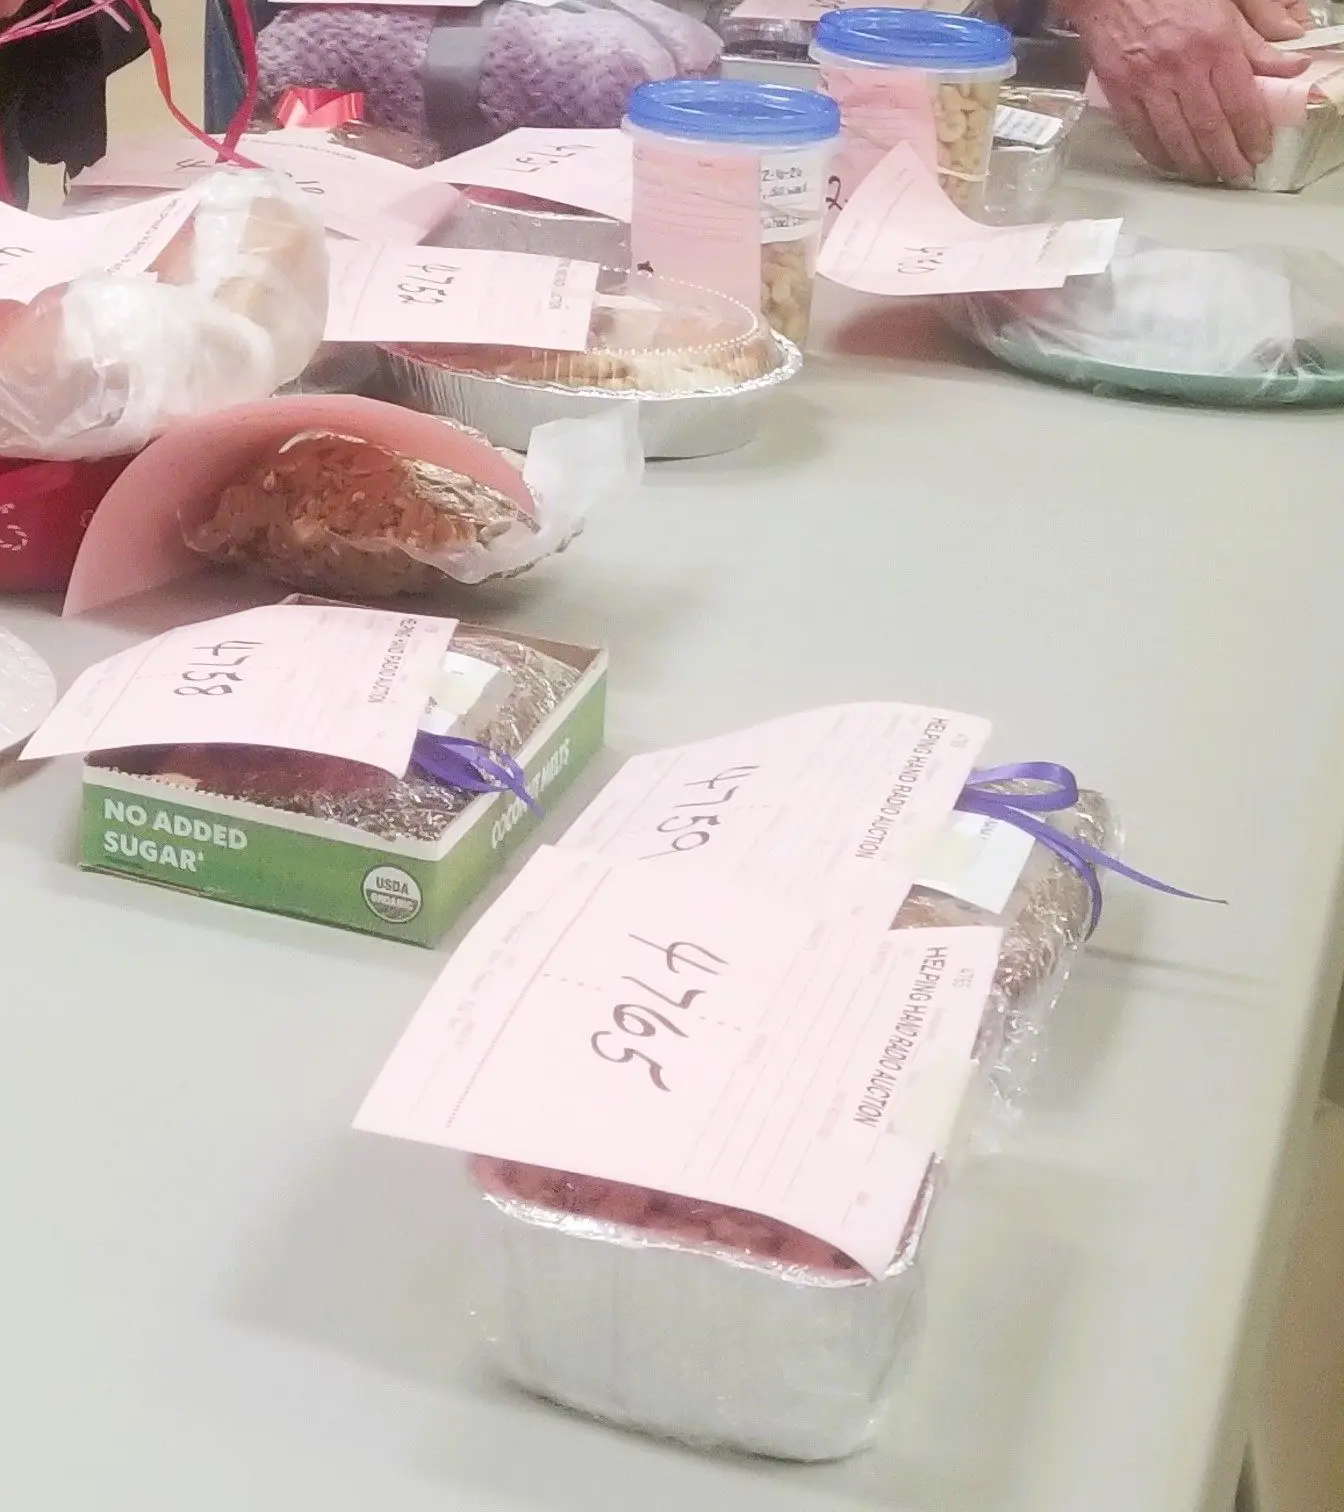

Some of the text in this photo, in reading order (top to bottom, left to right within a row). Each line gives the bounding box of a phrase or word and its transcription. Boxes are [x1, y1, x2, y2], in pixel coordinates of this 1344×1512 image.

[172, 638, 265, 699] 4758
[898, 755, 928, 784] HAND
[103, 797, 249, 851] NO ADDED
[638, 764, 761, 862] 4759
[880, 785, 913, 815] RADIO
[854, 814, 896, 860] AUCTION
[375, 875, 410, 896] USDA
[589, 932, 731, 1093] 4765
[852, 945, 949, 1128] HELPING HAND RADIO AUCTION
